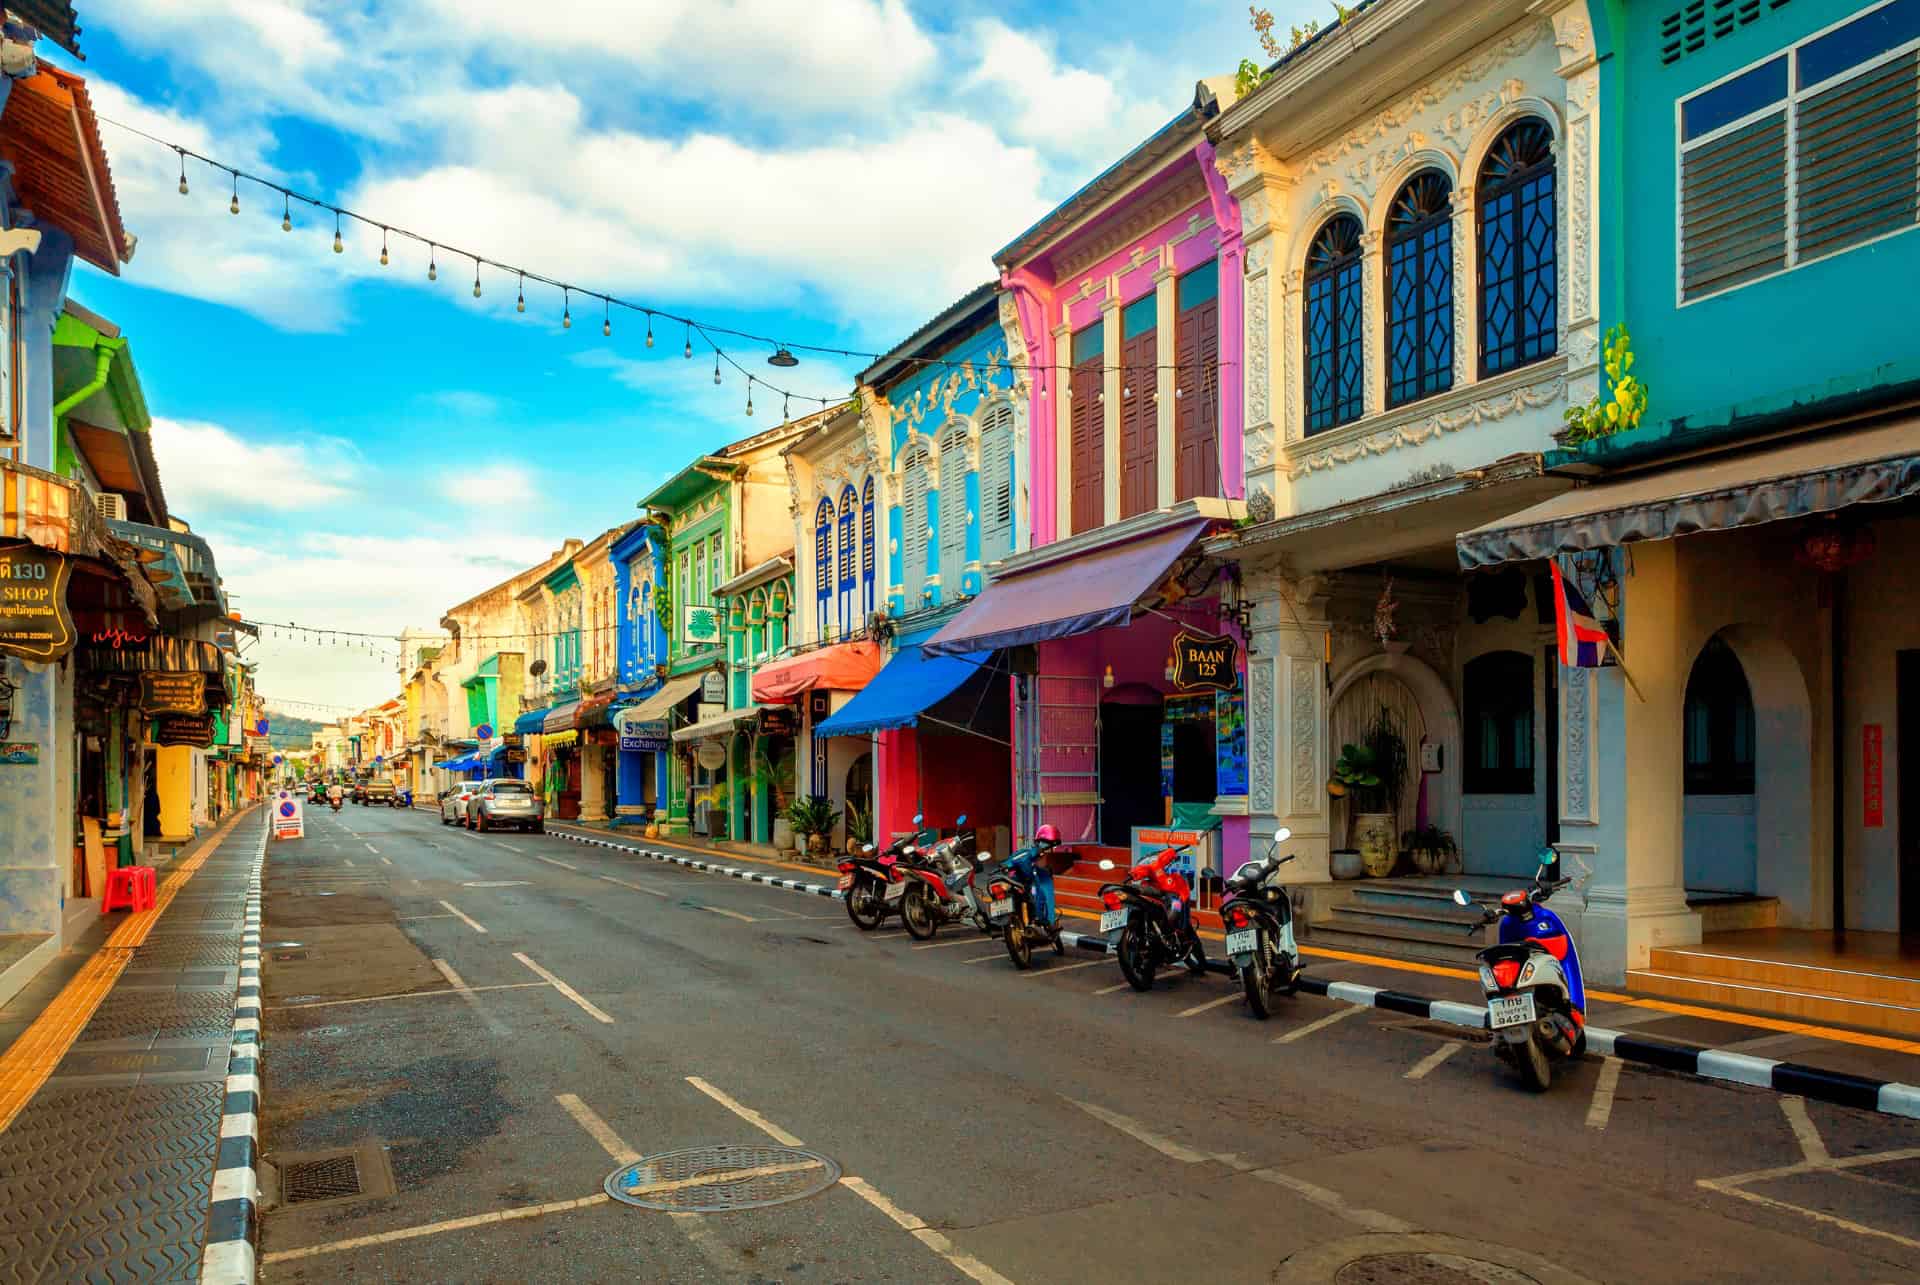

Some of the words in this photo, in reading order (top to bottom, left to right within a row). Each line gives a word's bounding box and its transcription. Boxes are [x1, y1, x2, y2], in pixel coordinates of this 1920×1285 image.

[14, 563, 46, 580] 130
[4, 587, 49, 601] SHOP
[1189, 648, 1225, 664] BAAN
[1199, 663, 1217, 676] 125
[623, 738, 668, 750] Exchange
